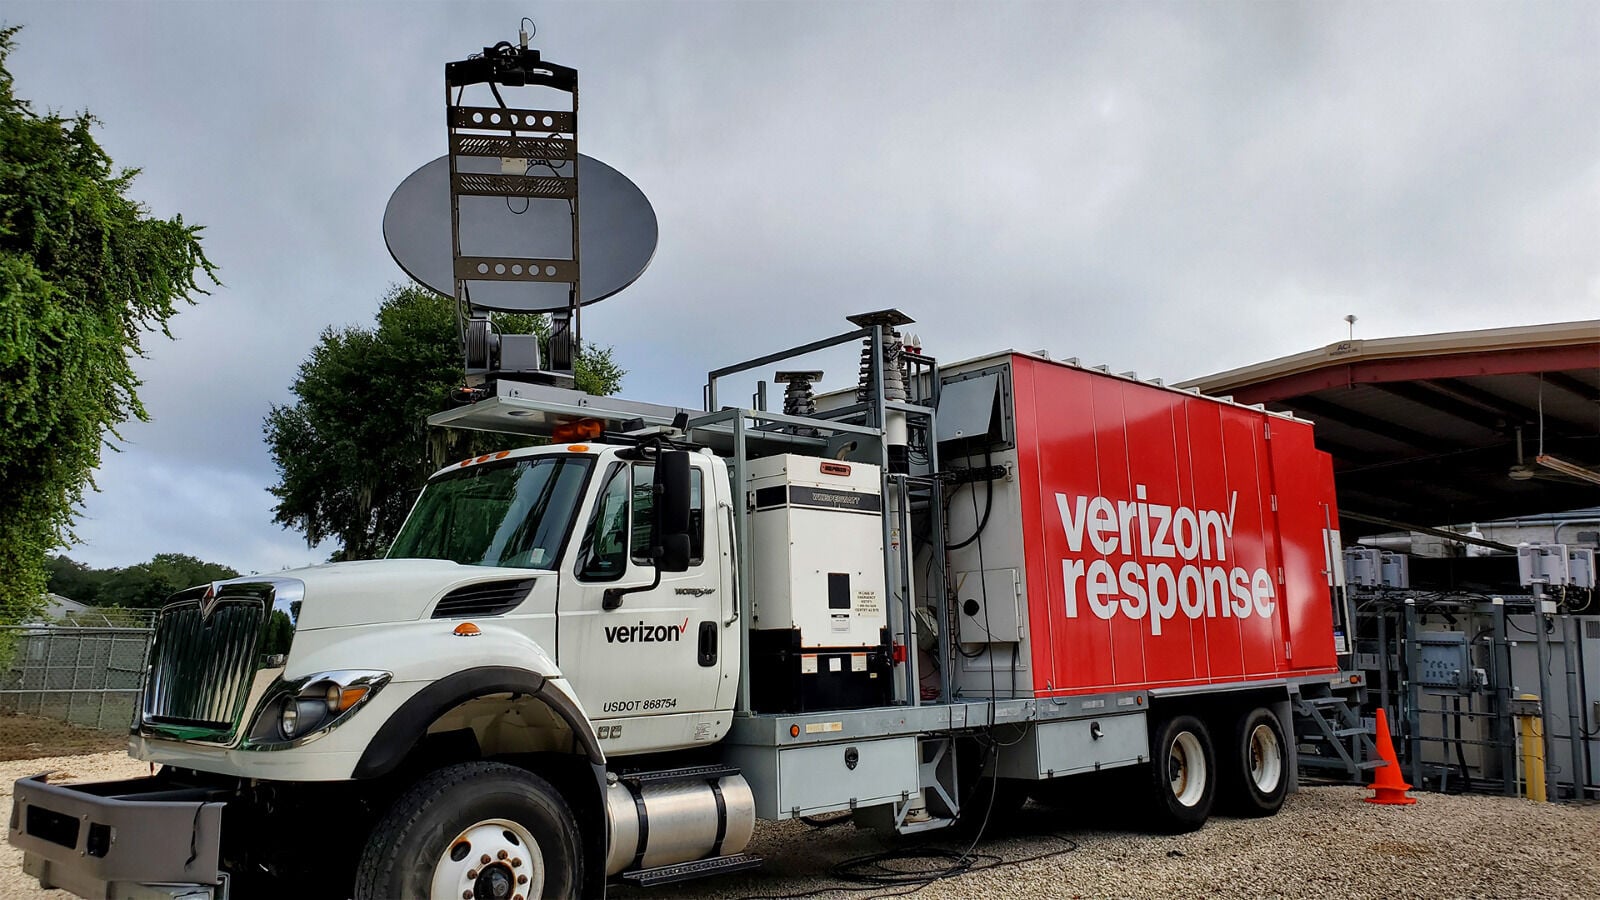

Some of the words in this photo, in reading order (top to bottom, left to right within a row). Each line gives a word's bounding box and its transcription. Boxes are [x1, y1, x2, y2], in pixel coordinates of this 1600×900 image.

[1055, 485, 1226, 561] verizon
[1062, 559, 1275, 636] response
[604, 621, 680, 643] verizon
[603, 701, 641, 712] USDOT
[643, 699, 677, 710] 868754
